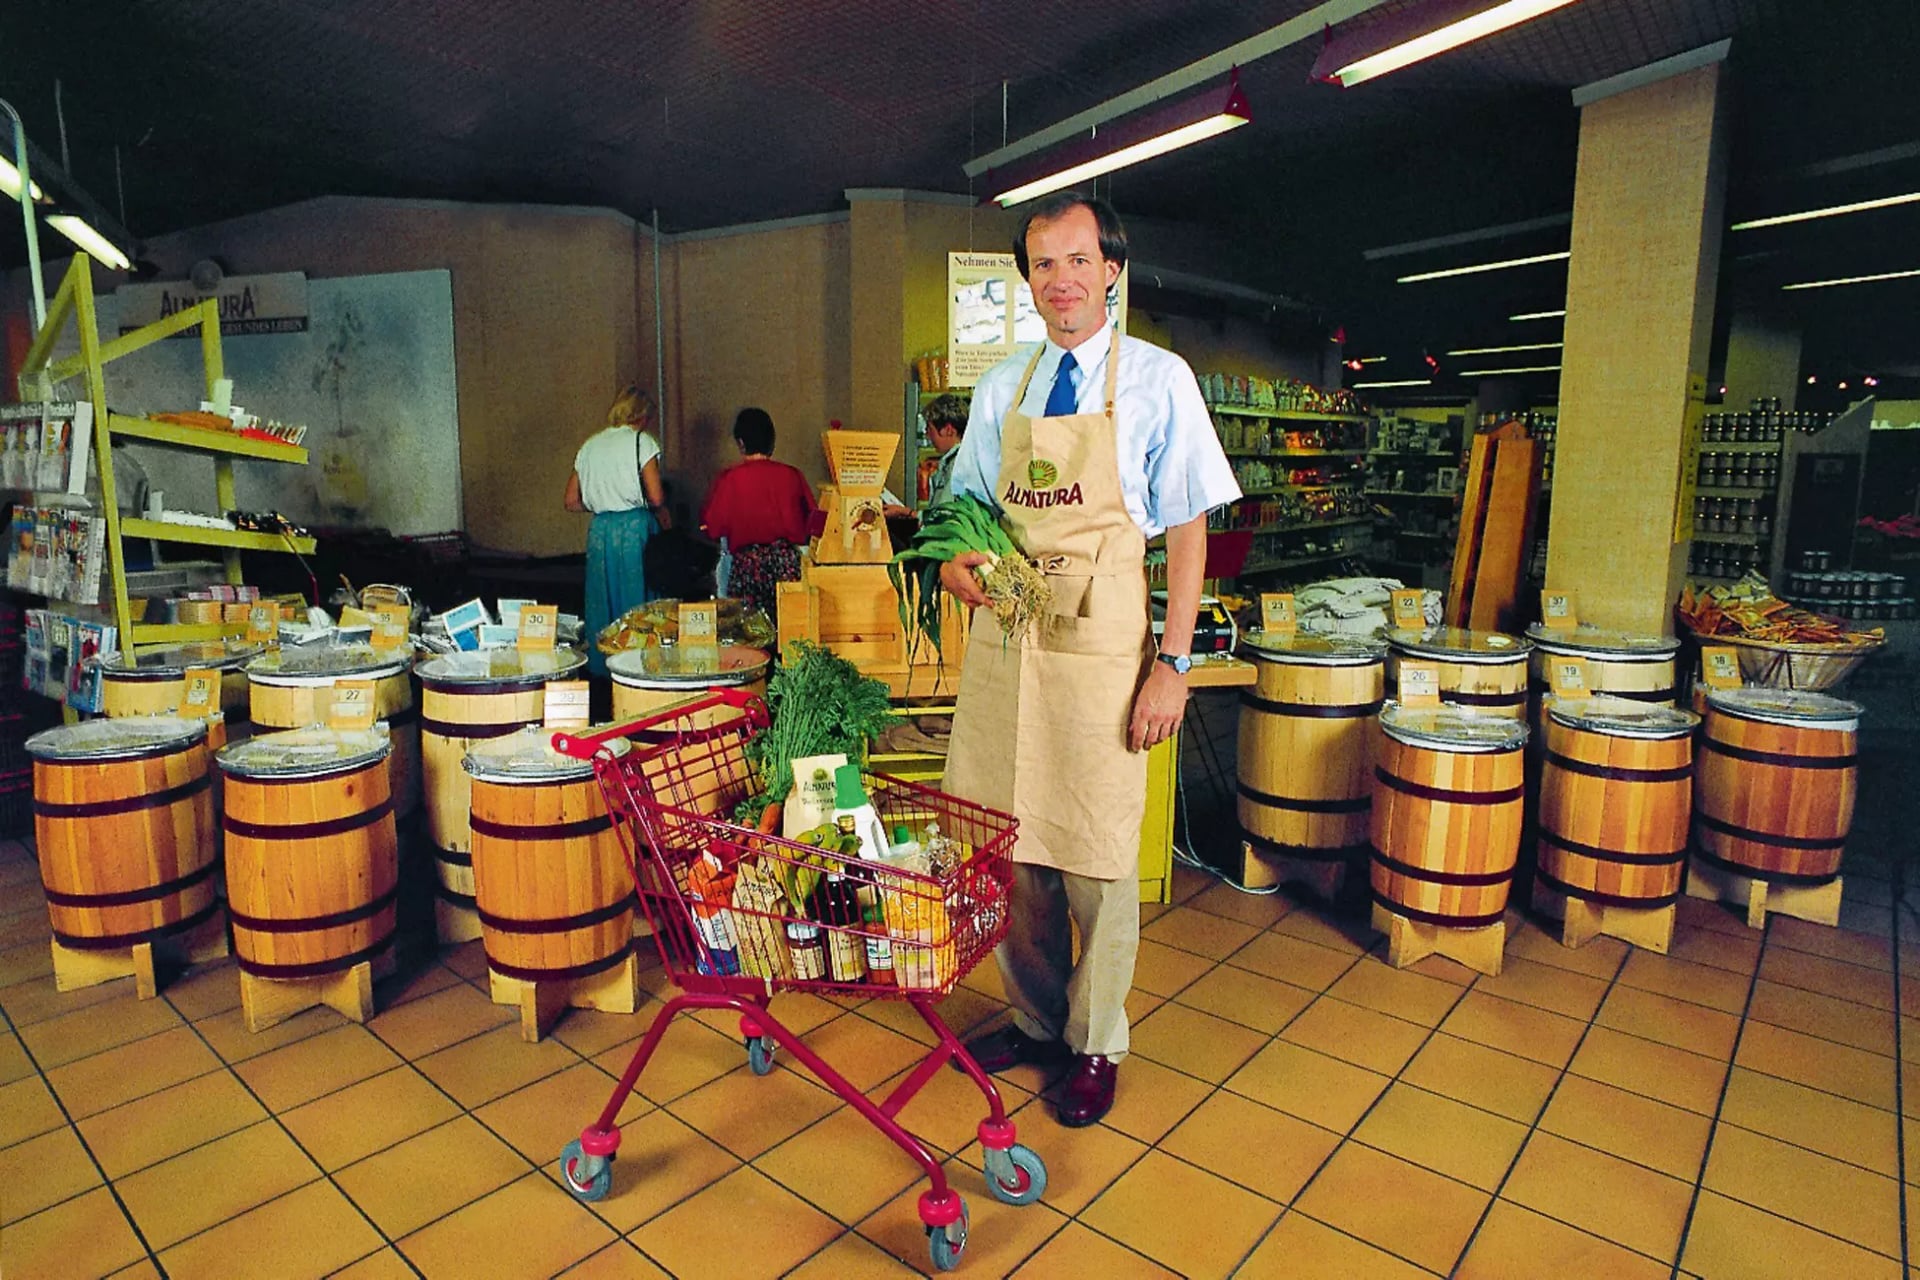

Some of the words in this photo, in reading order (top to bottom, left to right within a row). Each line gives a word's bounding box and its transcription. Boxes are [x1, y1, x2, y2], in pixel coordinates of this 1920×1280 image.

[954, 255, 996, 267] Nehmen
[999, 256, 1014, 267] Sie
[160, 286, 256, 319] ALNURA
[1003, 481, 1083, 509] ALNATURA
[1272, 602, 1283, 610] 23
[1403, 598, 1413, 606] 22
[529, 614, 544, 624] 30
[691, 612, 704, 622] 33
[1714, 655, 1725, 665] 18
[1565, 665, 1577, 675] 19
[196, 679, 205, 689] 31
[346, 690, 360, 700] 27
